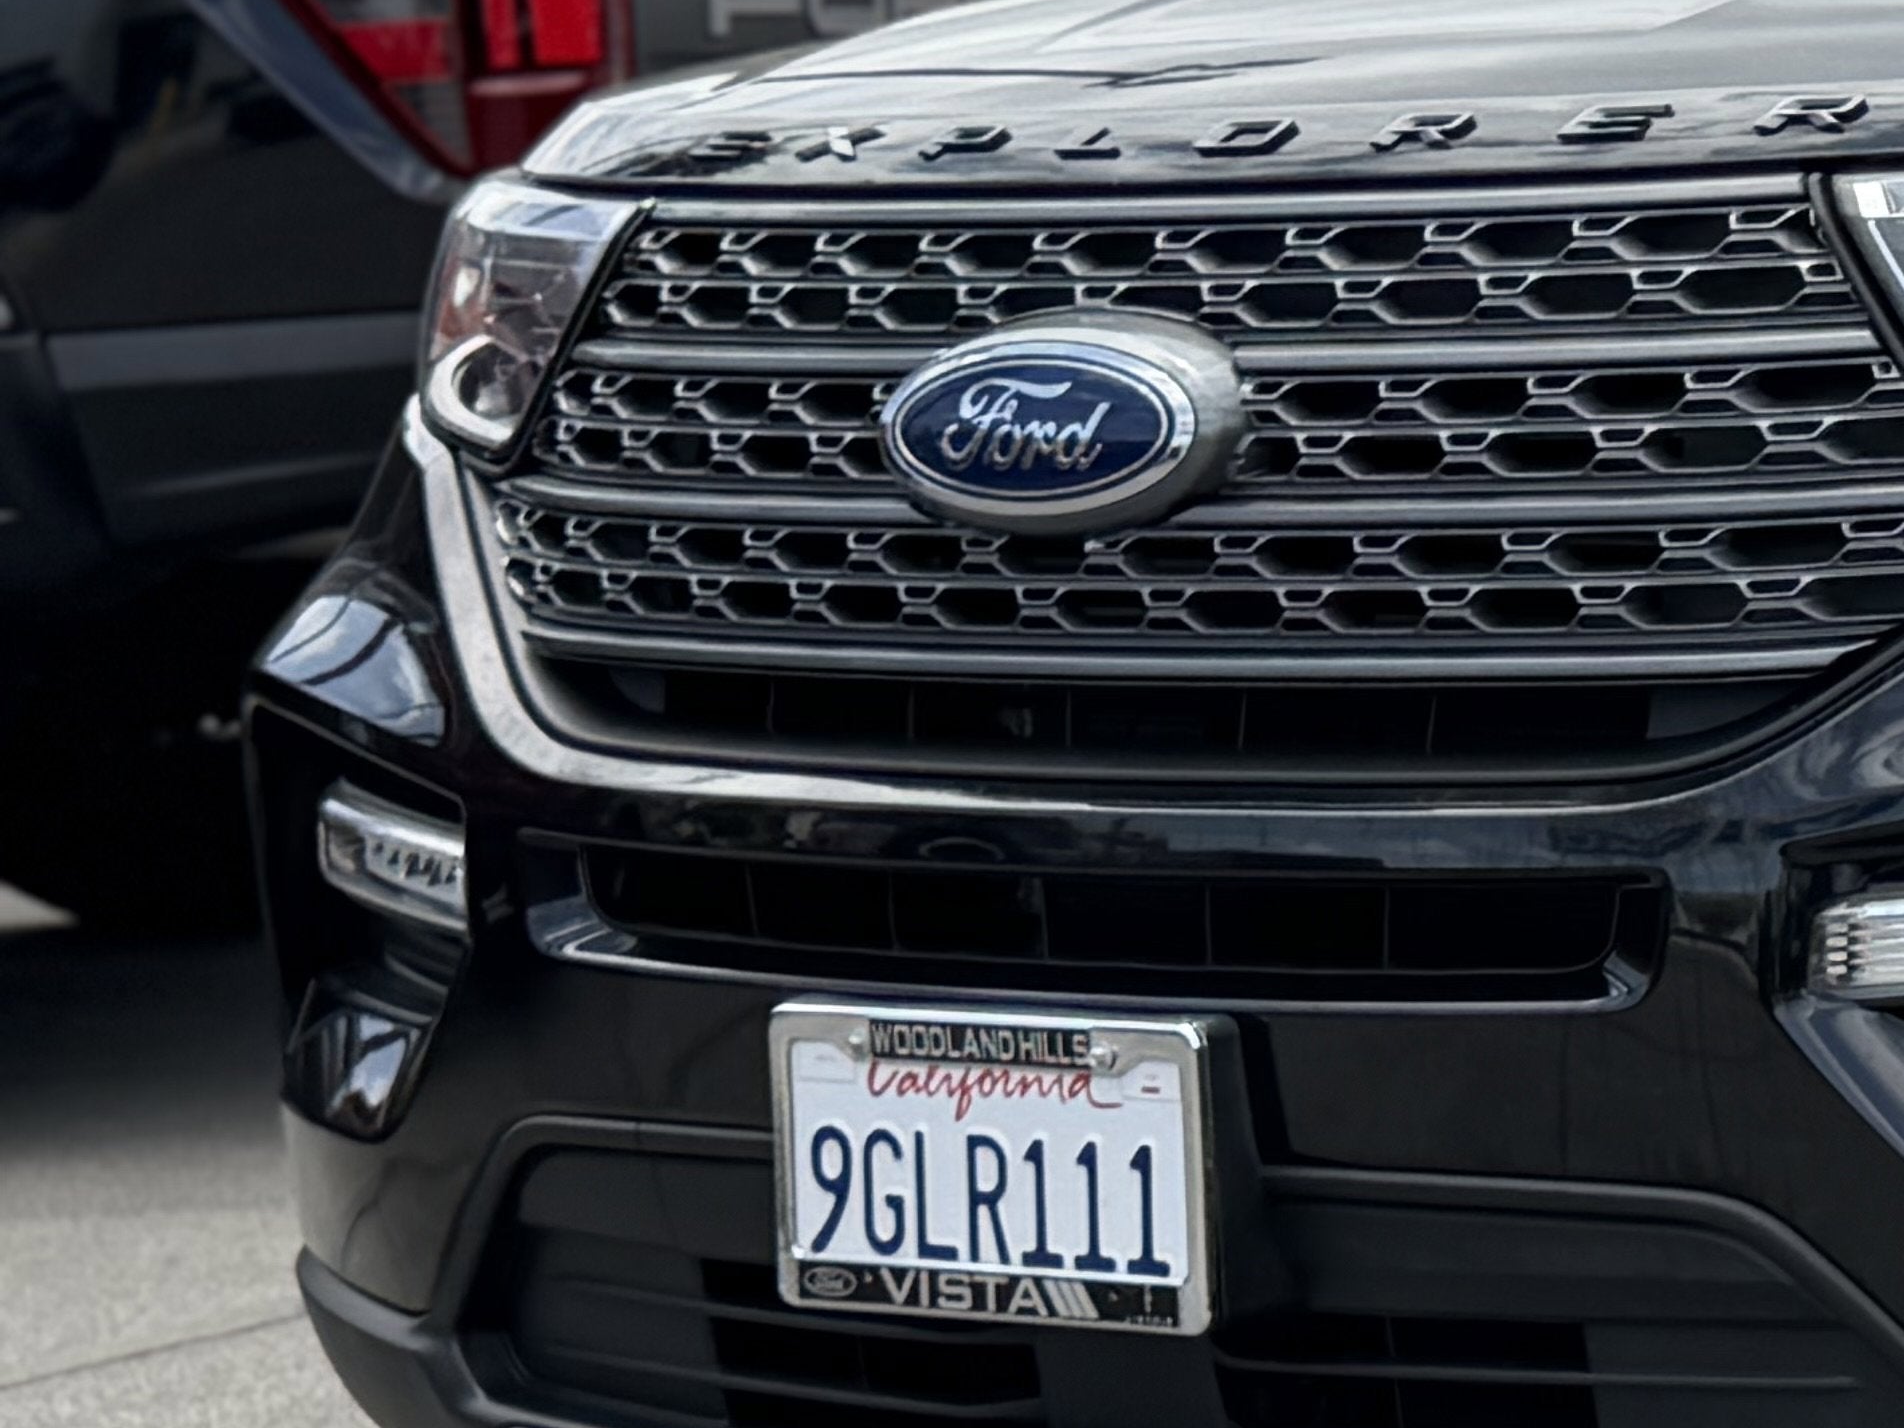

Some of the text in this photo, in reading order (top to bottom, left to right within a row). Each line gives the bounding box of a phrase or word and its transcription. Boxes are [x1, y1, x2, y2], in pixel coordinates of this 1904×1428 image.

[686, 92, 1870, 170] EXPLORER
[939, 376, 1113, 472] Ford
[871, 1022, 1089, 1062] WOODLAND HILLS
[866, 1059, 1123, 1122] California
[810, 1124, 1171, 1277] 9GLR111
[879, 1267, 1050, 1317] VISTA
